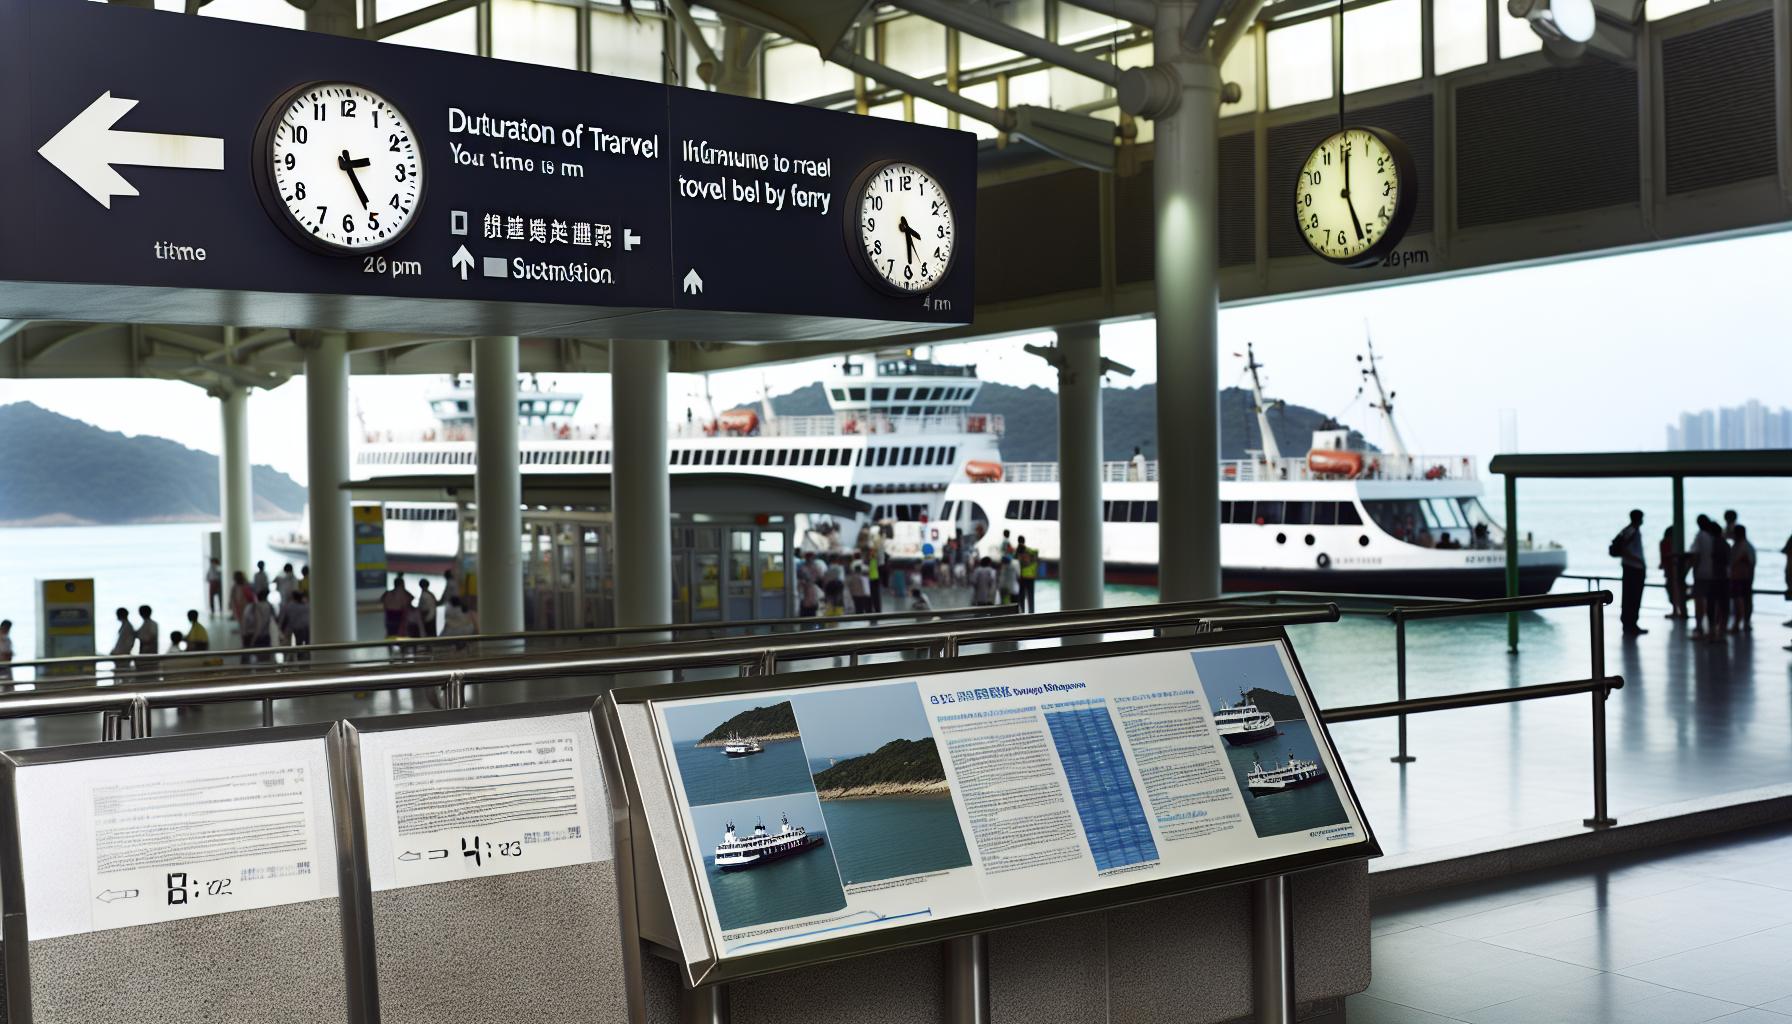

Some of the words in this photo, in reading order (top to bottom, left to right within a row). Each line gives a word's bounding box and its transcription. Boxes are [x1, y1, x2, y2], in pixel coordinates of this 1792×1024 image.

[313, 103, 326, 121] 11
[340, 99, 357, 118] 12
[371, 110, 379, 129] 1
[291, 125, 308, 144] 10
[389, 134, 401, 152] 2
[561, 123, 584, 149] of
[284, 153, 296, 171] 9
[772, 153, 790, 173] to
[394, 163, 406, 182] 3
[295, 181, 306, 201] 8
[885, 178, 894, 193] 11
[389, 193, 400, 210] 4
[764, 181, 786, 212] by
[316, 205, 328, 225] 7
[342, 214, 355, 233] 6
[367, 211, 380, 231] 5
